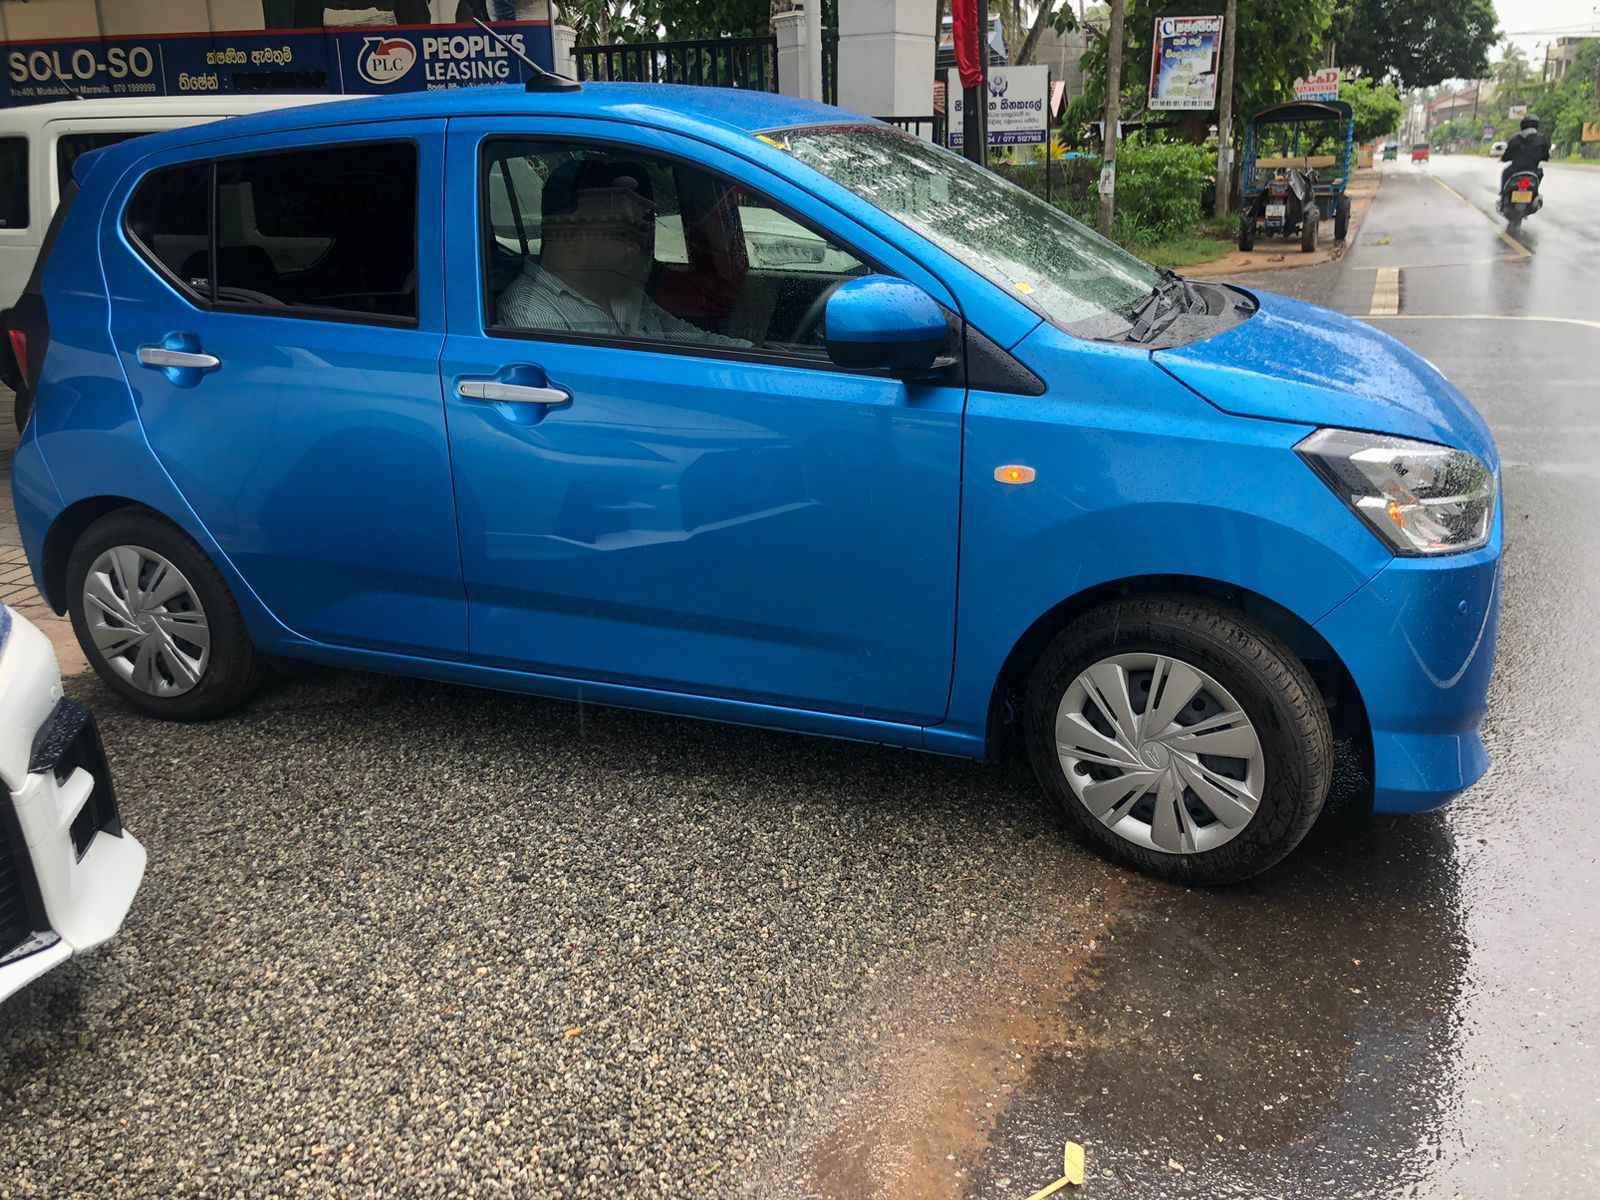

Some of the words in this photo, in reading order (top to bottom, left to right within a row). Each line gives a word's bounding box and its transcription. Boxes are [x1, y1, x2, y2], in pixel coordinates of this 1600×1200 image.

[422, 33, 526, 60] PEOPLE'S
[9, 46, 153, 82] SOLO-SO
[372, 58, 404, 72] PLC
[425, 60, 510, 81] LEASING
